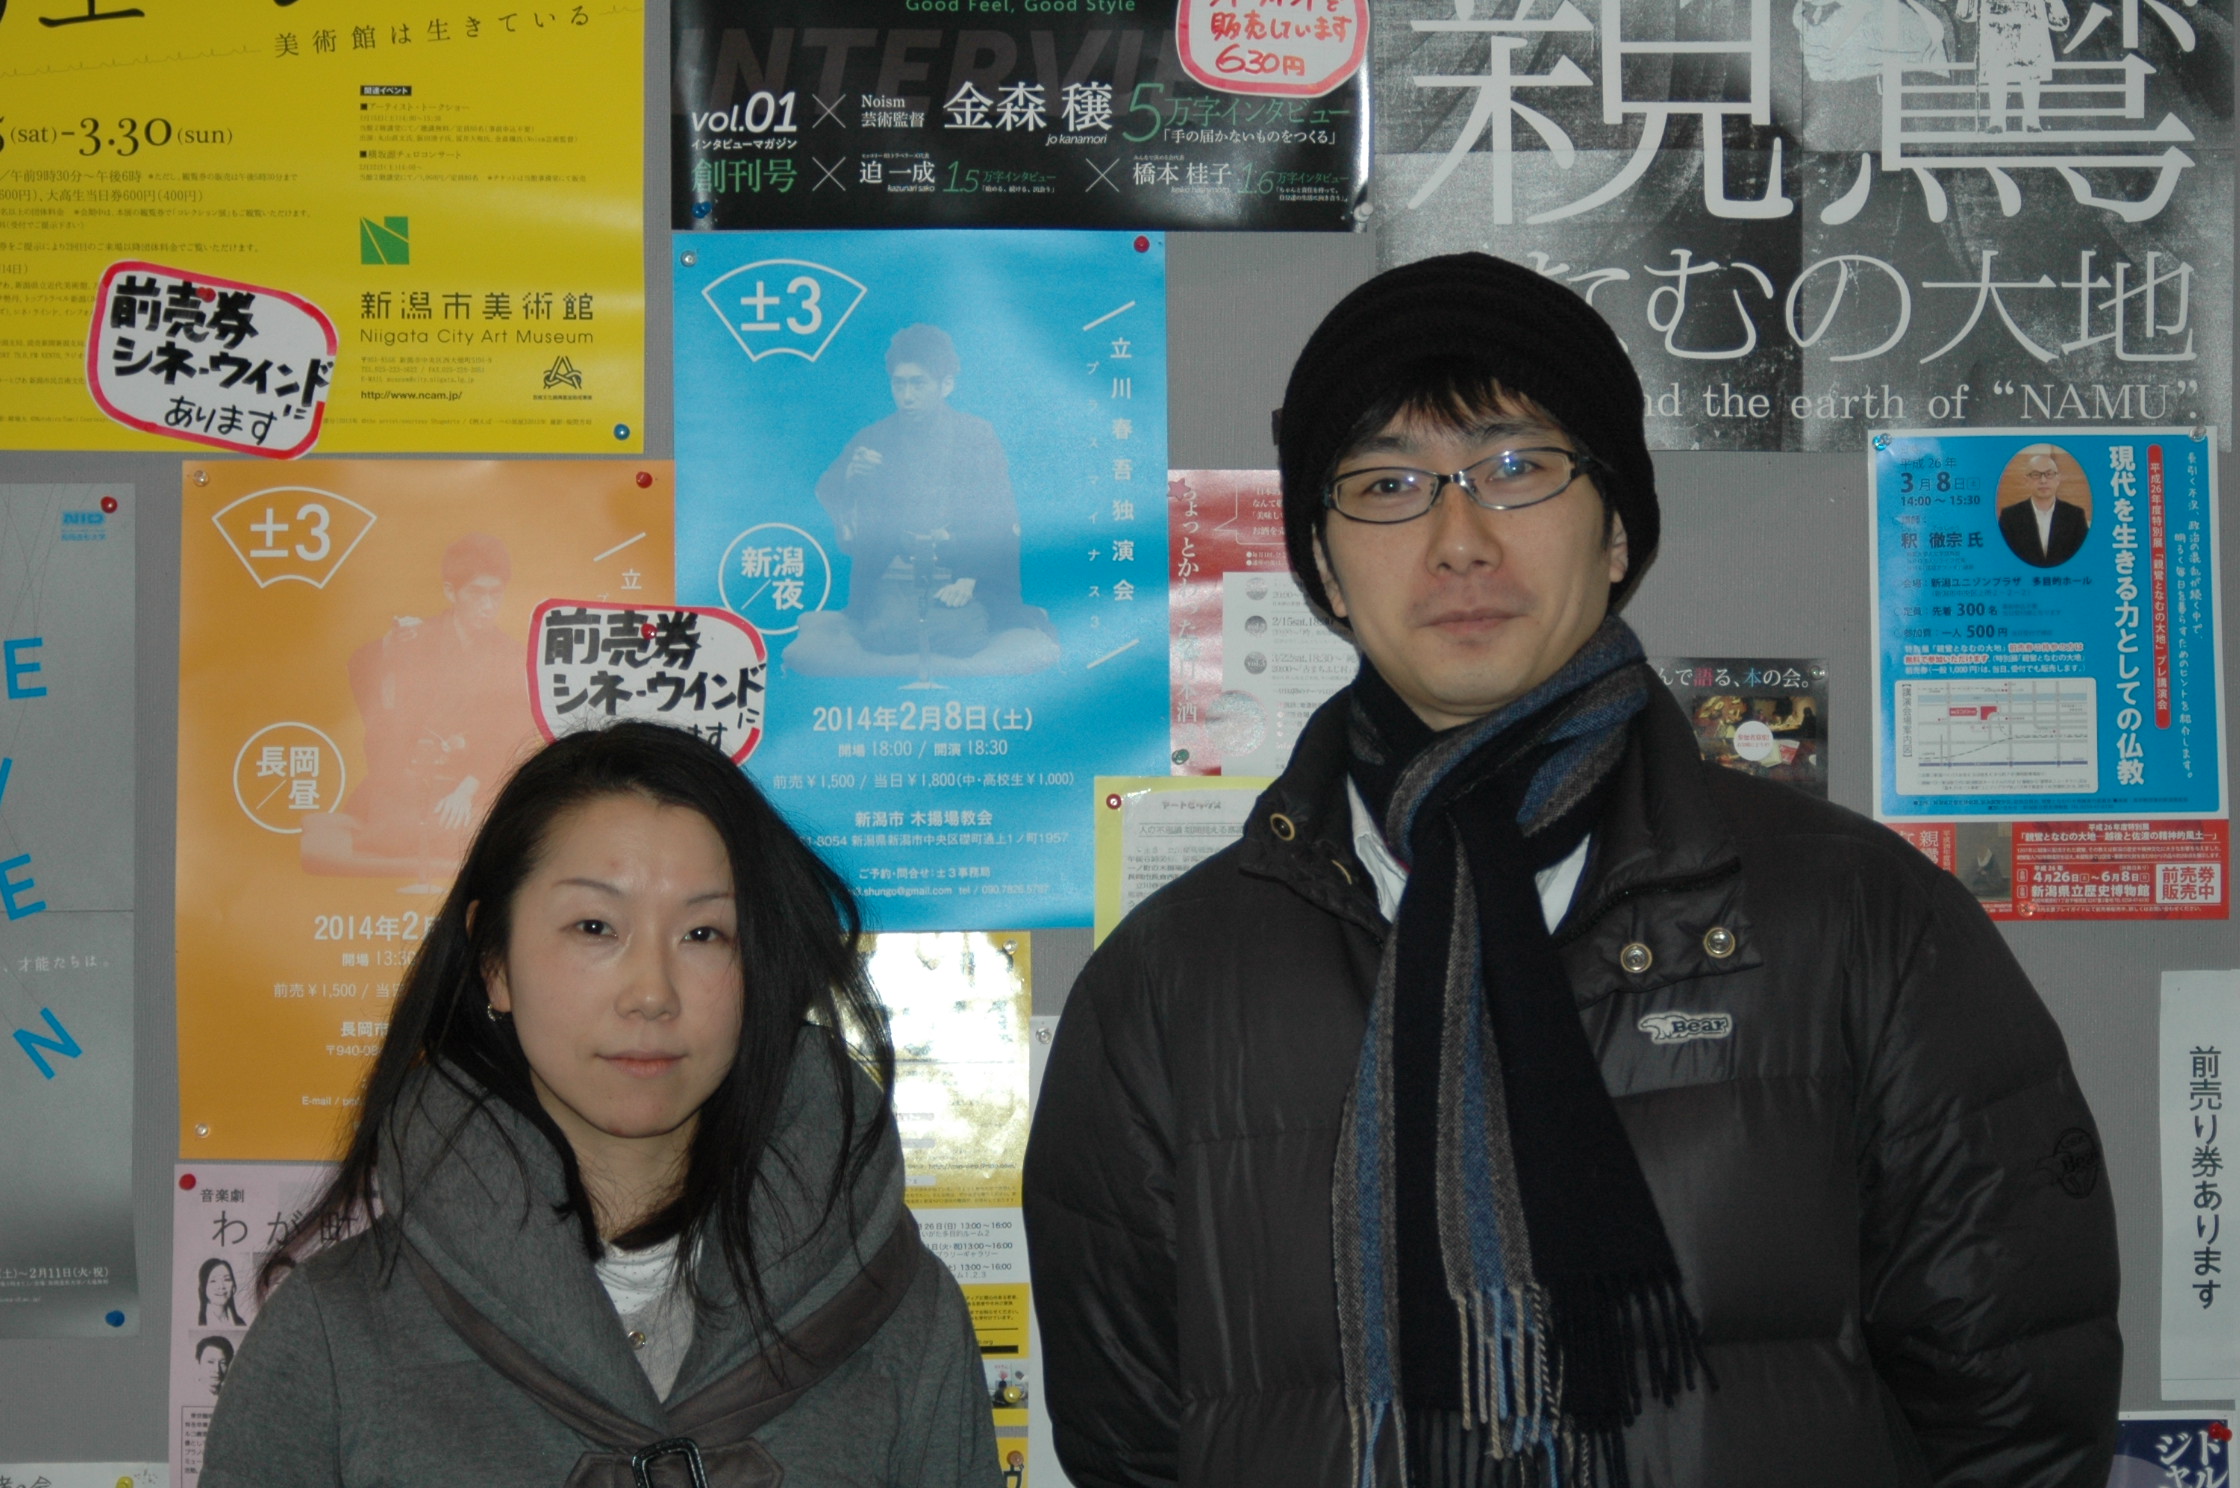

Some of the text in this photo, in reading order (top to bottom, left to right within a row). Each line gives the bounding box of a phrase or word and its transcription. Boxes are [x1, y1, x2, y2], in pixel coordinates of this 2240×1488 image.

[906, 0, 959, 12] Good
[1024, 0, 1078, 12] Good
[1086, 0, 1136, 12] Style
[273, 5, 590, 58] 美術館は生きている
[1210, 9, 1353, 43] 販売しています
[1215, 43, 1305, 77] 630円
[692, 91, 798, 132] vol.01
[861, 94, 906, 108] Noism
[943, 81, 1113, 132] 金森 穣
[861, 111, 925, 129] 芸術監督
[691, 138, 798, 150] インタビューマガジン
[1045, 133, 1108, 147] jo kanamori
[1163, 129, 1337, 145] 「手の届かないものをつくる」
[691, 158, 798, 194] 創刊号
[859, 161, 935, 184] 迫 一成
[1132, 162, 1232, 185] 橋本 桂子
[110, 274, 259, 350] 前売券
[360, 291, 594, 321] 新潟市美術館
[740, 276, 823, 335] ±3
[360, 328, 594, 347] Niigata City Art Museum
[360, 390, 463, 402] http://www.ncam.jp/
[1704, 380, 1771, 419] the
[1791, 383, 1908, 419] earth
[1926, 381, 1969, 419] of
[164, 395, 277, 446] あります
[1110, 337, 1136, 602] 立川春吾独演会
[250, 503, 331, 562] ±3
[1929, 532, 1963, 549] 徹宗
[740, 546, 804, 578] 新潟
[1931, 576, 2022, 588] 新潟ユニゾンプラザ
[2032, 576, 2092, 587] 多目的ホール
[771, 577, 805, 611] 夜
[1957, 603, 1985, 617] 300
[2108, 446, 2146, 786] 現代を生きる力としての仏教
[544, 607, 702, 671] 前売券
[1966, 625, 1995, 638] 500
[812, 701, 1033, 732] 2014年2月8日(土)
[838, 743, 865, 758] 開場
[871, 741, 912, 757] 18:00
[934, 743, 961, 758] 開演
[967, 739, 1008, 756] 18:30
[256, 745, 321, 780] 長岡
[288, 780, 321, 810] 昼
[855, 810, 993, 828] 新潟市 木揚場教会
[2161, 866, 2215, 884] 前売券
[2031, 884, 2150, 898] 新潟県立歴史博物館
[2161, 883, 2215, 901] 販売中
[341, 952, 369, 967] 開場
[1671, 1019, 1727, 1033] Bear
[302, 1096, 332, 1106] E-mail
[2188, 1044, 2225, 1310] 前売り券あります
[200, 1188, 245, 1204] 音楽劇
